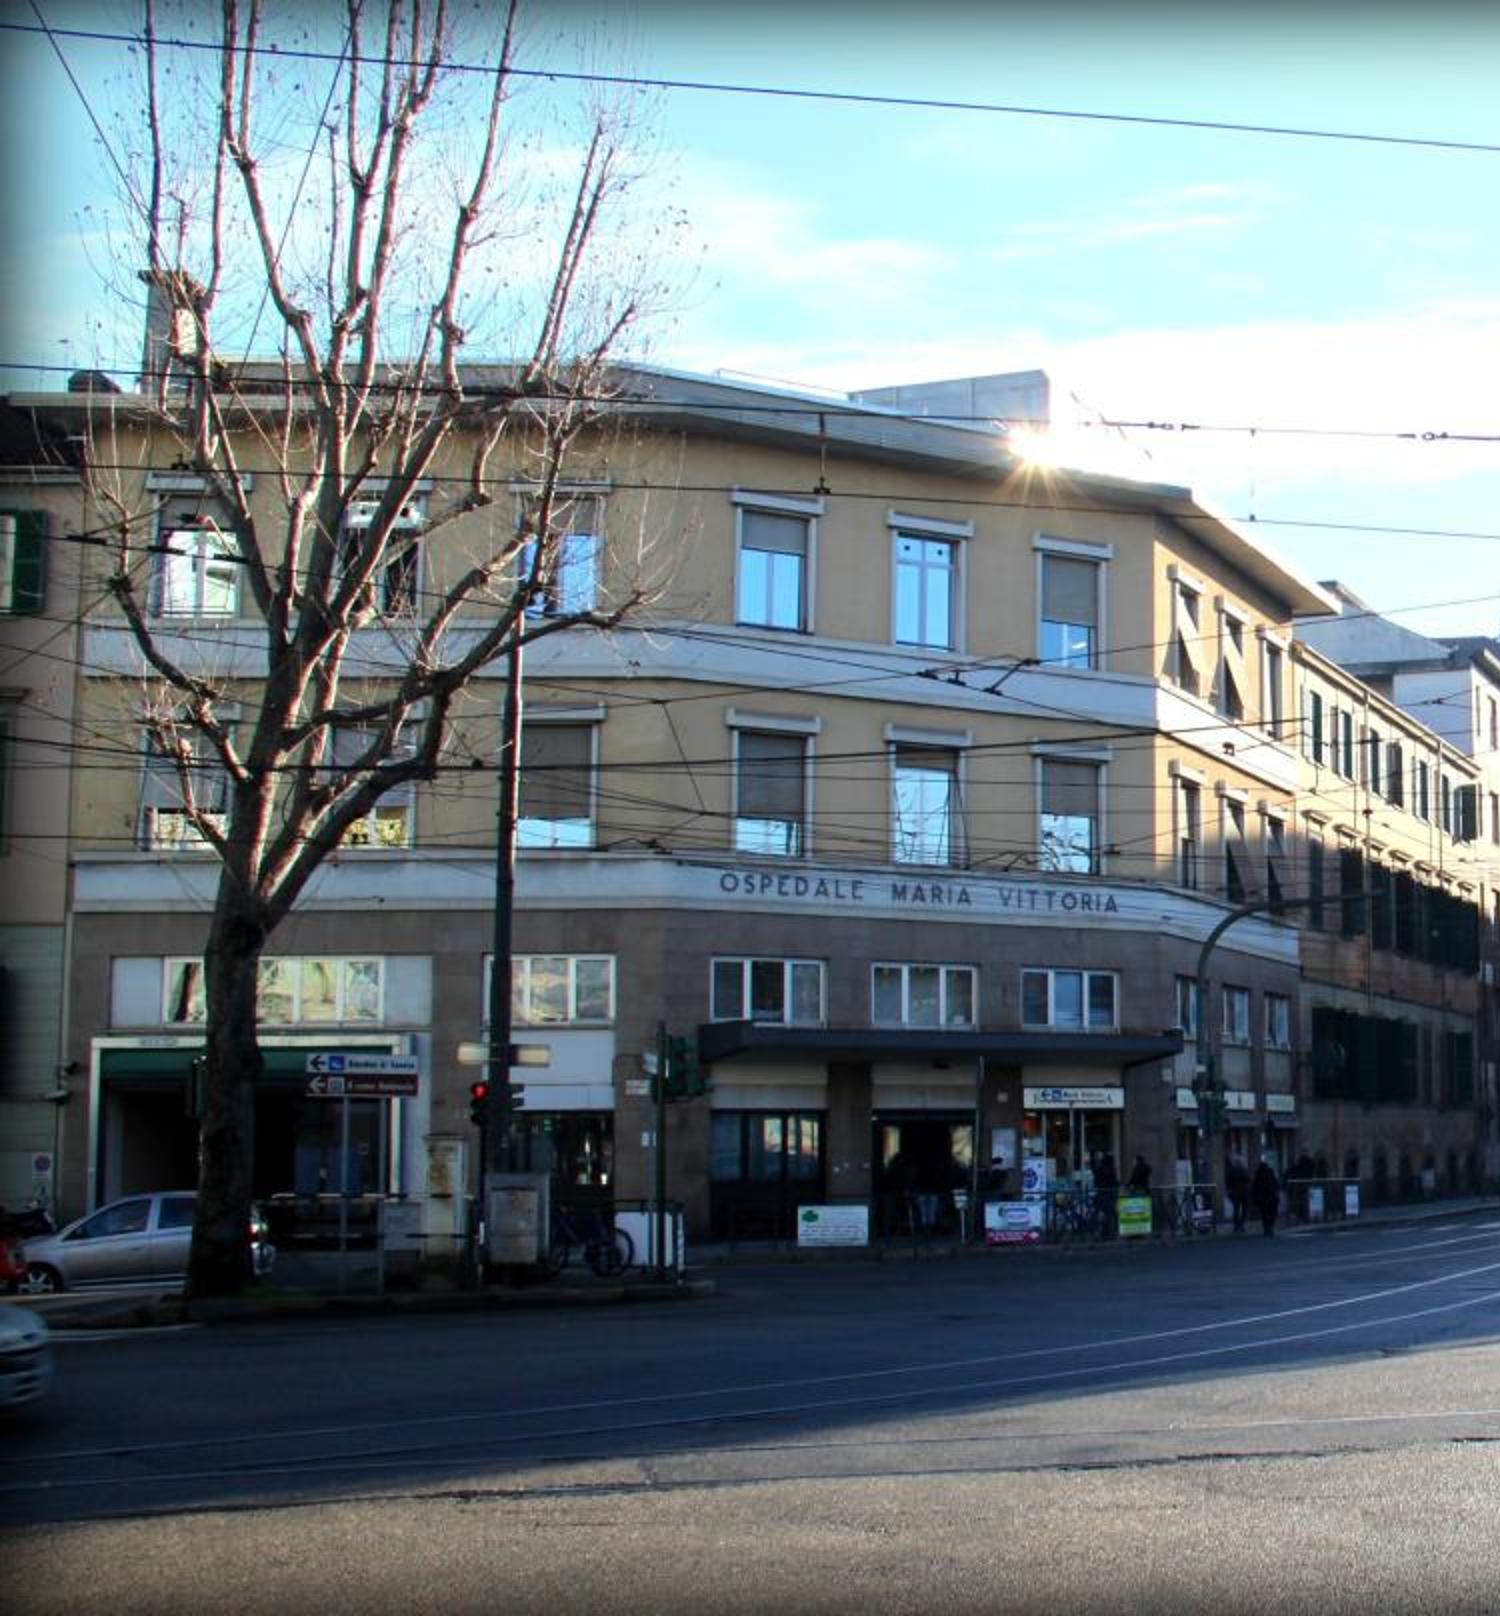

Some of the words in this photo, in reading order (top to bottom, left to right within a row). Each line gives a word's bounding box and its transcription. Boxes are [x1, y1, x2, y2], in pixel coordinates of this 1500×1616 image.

[719, 872, 864, 900] OSPEDALE
[891, 883, 973, 906] MARIA
[999, 888, 1120, 914] VITTORIA
